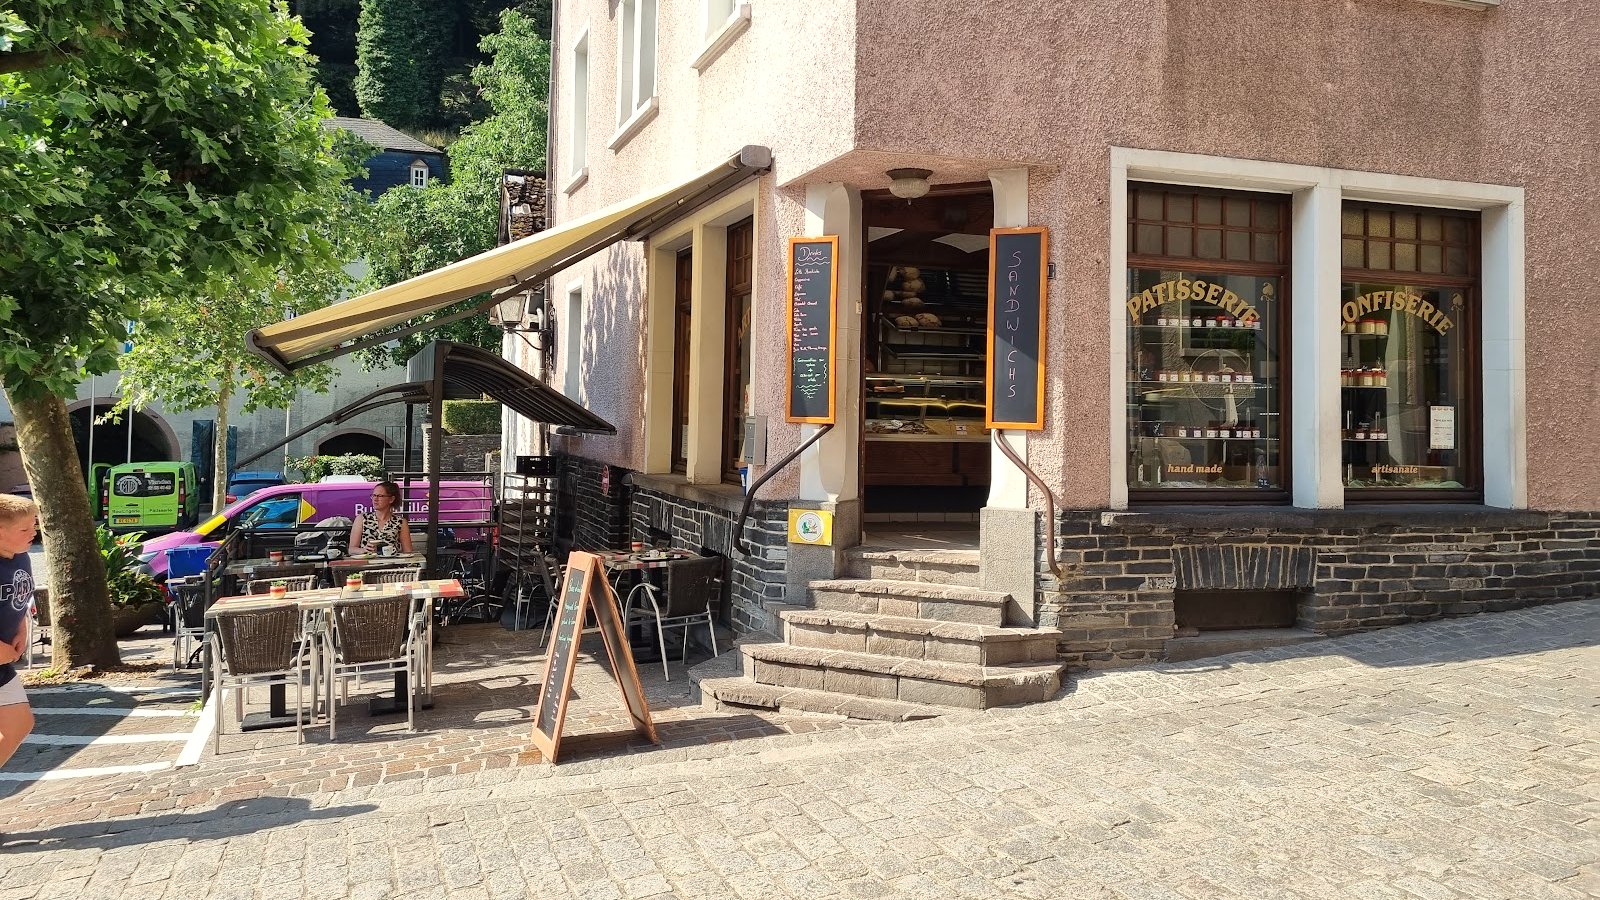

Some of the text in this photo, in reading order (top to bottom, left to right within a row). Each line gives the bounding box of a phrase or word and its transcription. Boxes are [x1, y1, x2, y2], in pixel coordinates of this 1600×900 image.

[1126, 279, 1261, 328] PATISSERIE
[1004, 250, 1022, 398] SANDWICHS
[1167, 463, 1223, 473] hand made
[1371, 463, 1418, 474] artisanale
